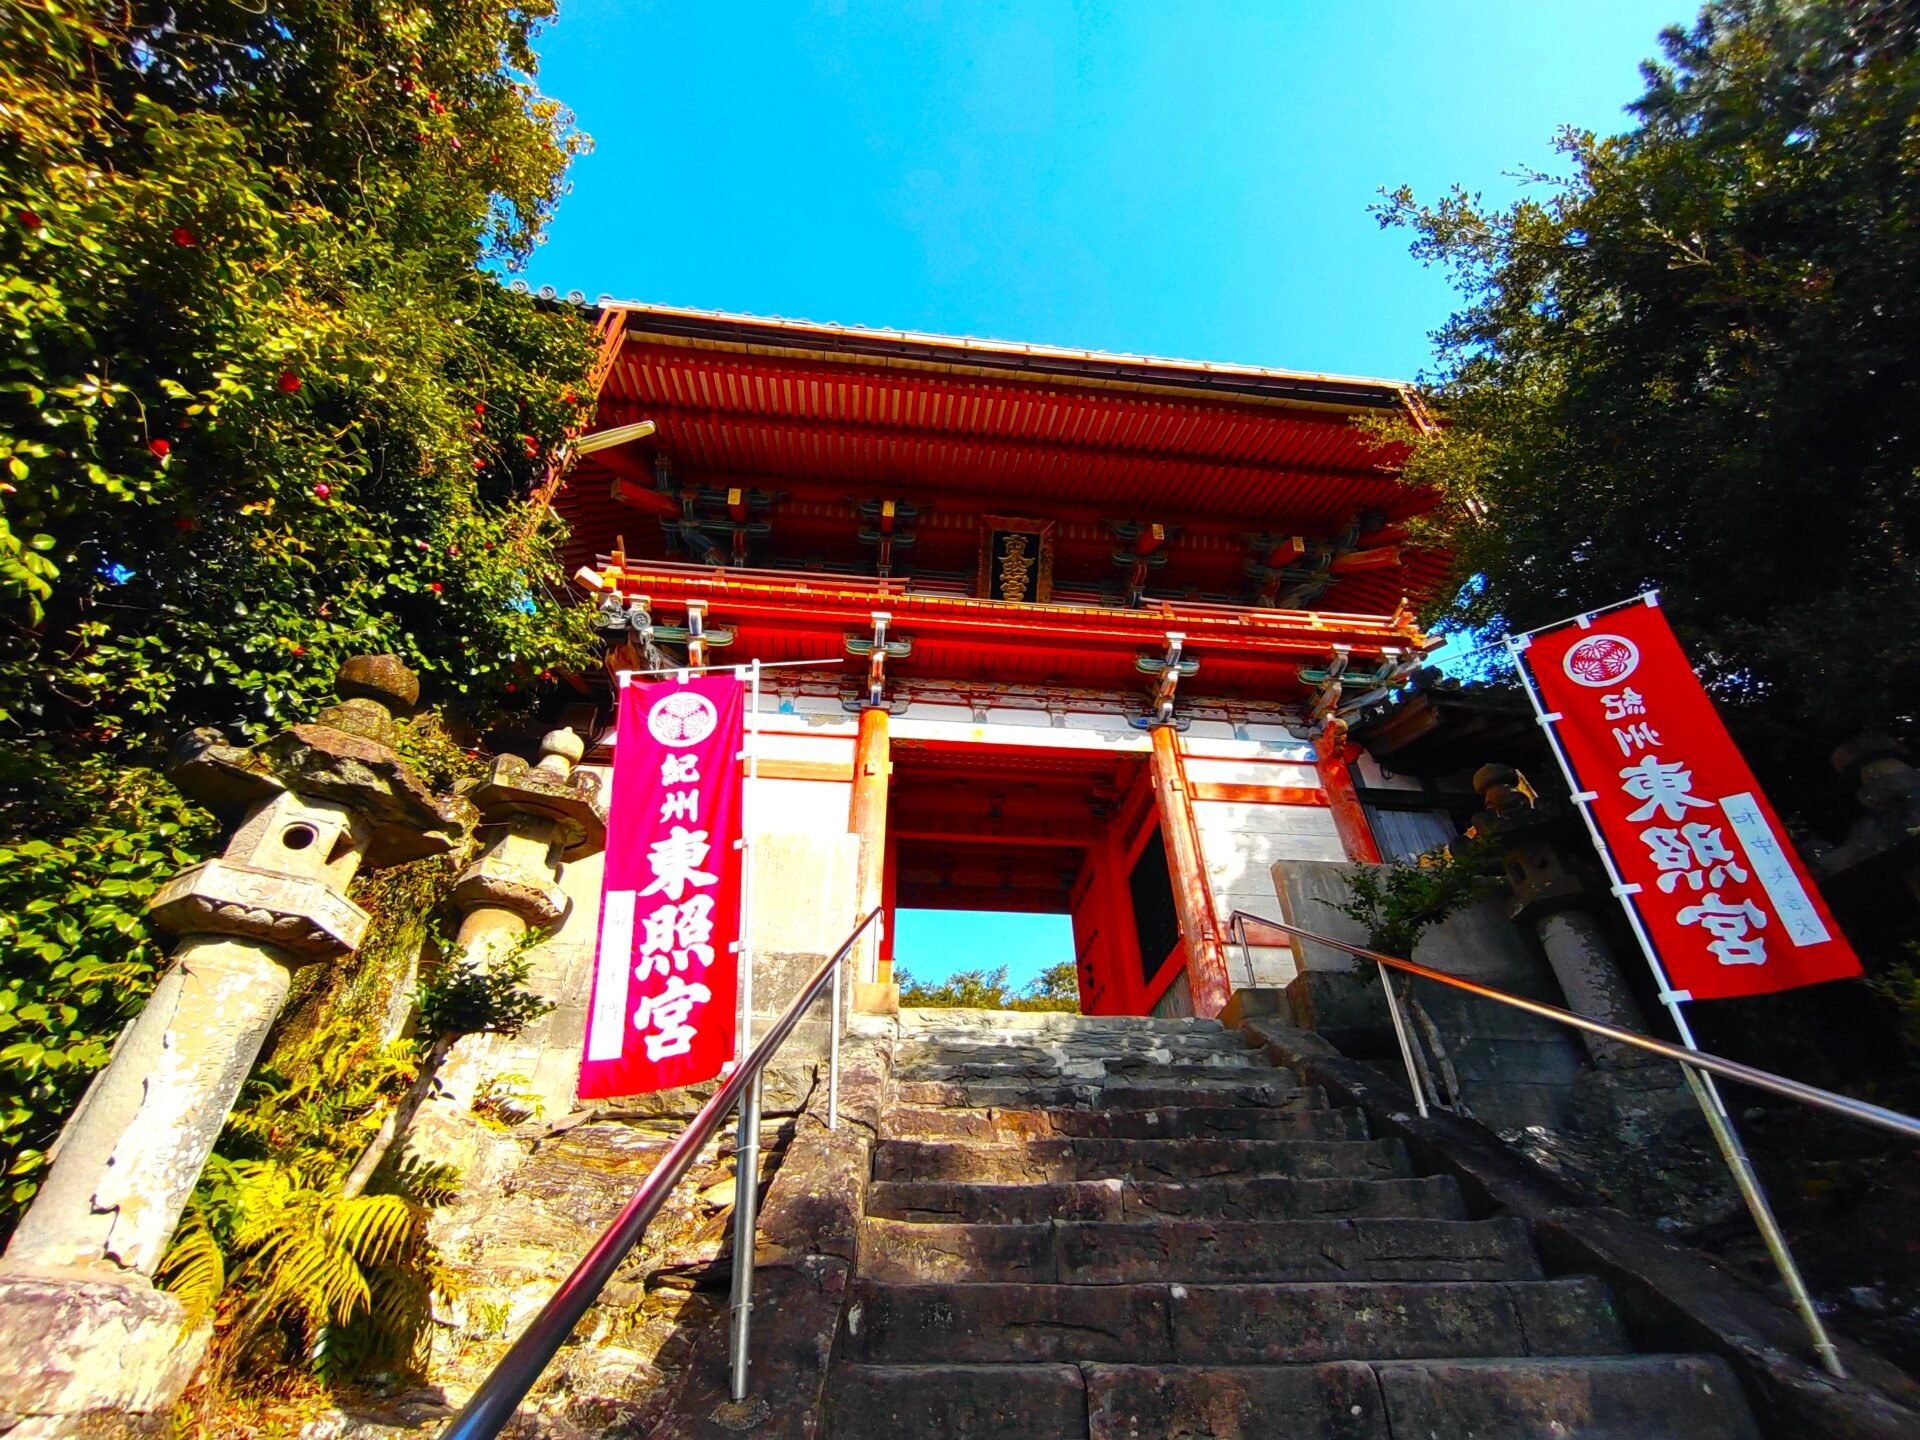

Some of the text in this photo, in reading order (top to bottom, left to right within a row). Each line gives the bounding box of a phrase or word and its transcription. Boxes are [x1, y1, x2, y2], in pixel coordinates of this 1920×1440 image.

[997, 534, 1036, 601] 東照宮
[634, 753, 720, 1063] 紀州東照宮
